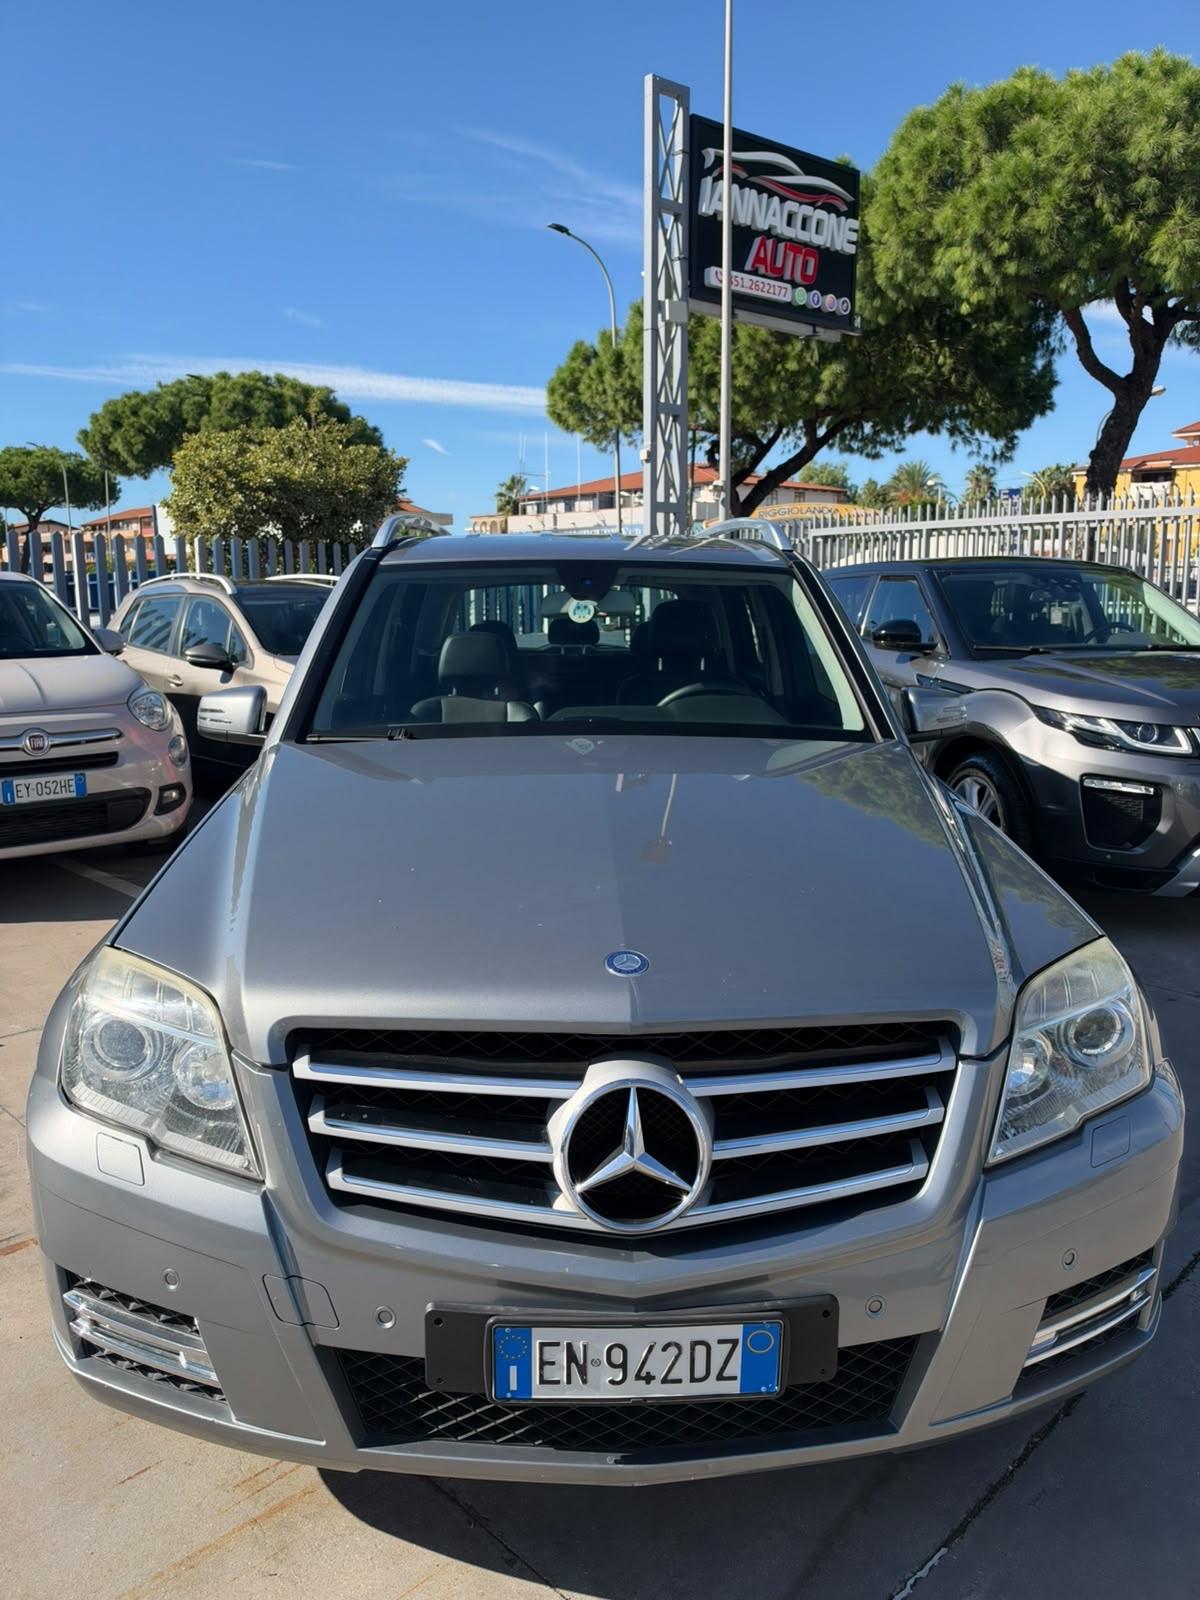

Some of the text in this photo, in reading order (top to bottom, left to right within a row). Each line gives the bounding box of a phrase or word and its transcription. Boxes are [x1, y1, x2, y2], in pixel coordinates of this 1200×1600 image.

[698, 176, 859, 254] IANNACCONE
[747, 235, 819, 285] AUTO
[15, 782, 32, 799] EY
[36, 778, 74, 797] 052HE
[537, 1340, 588, 1385] EN
[604, 1338, 739, 1385] 942DZ
